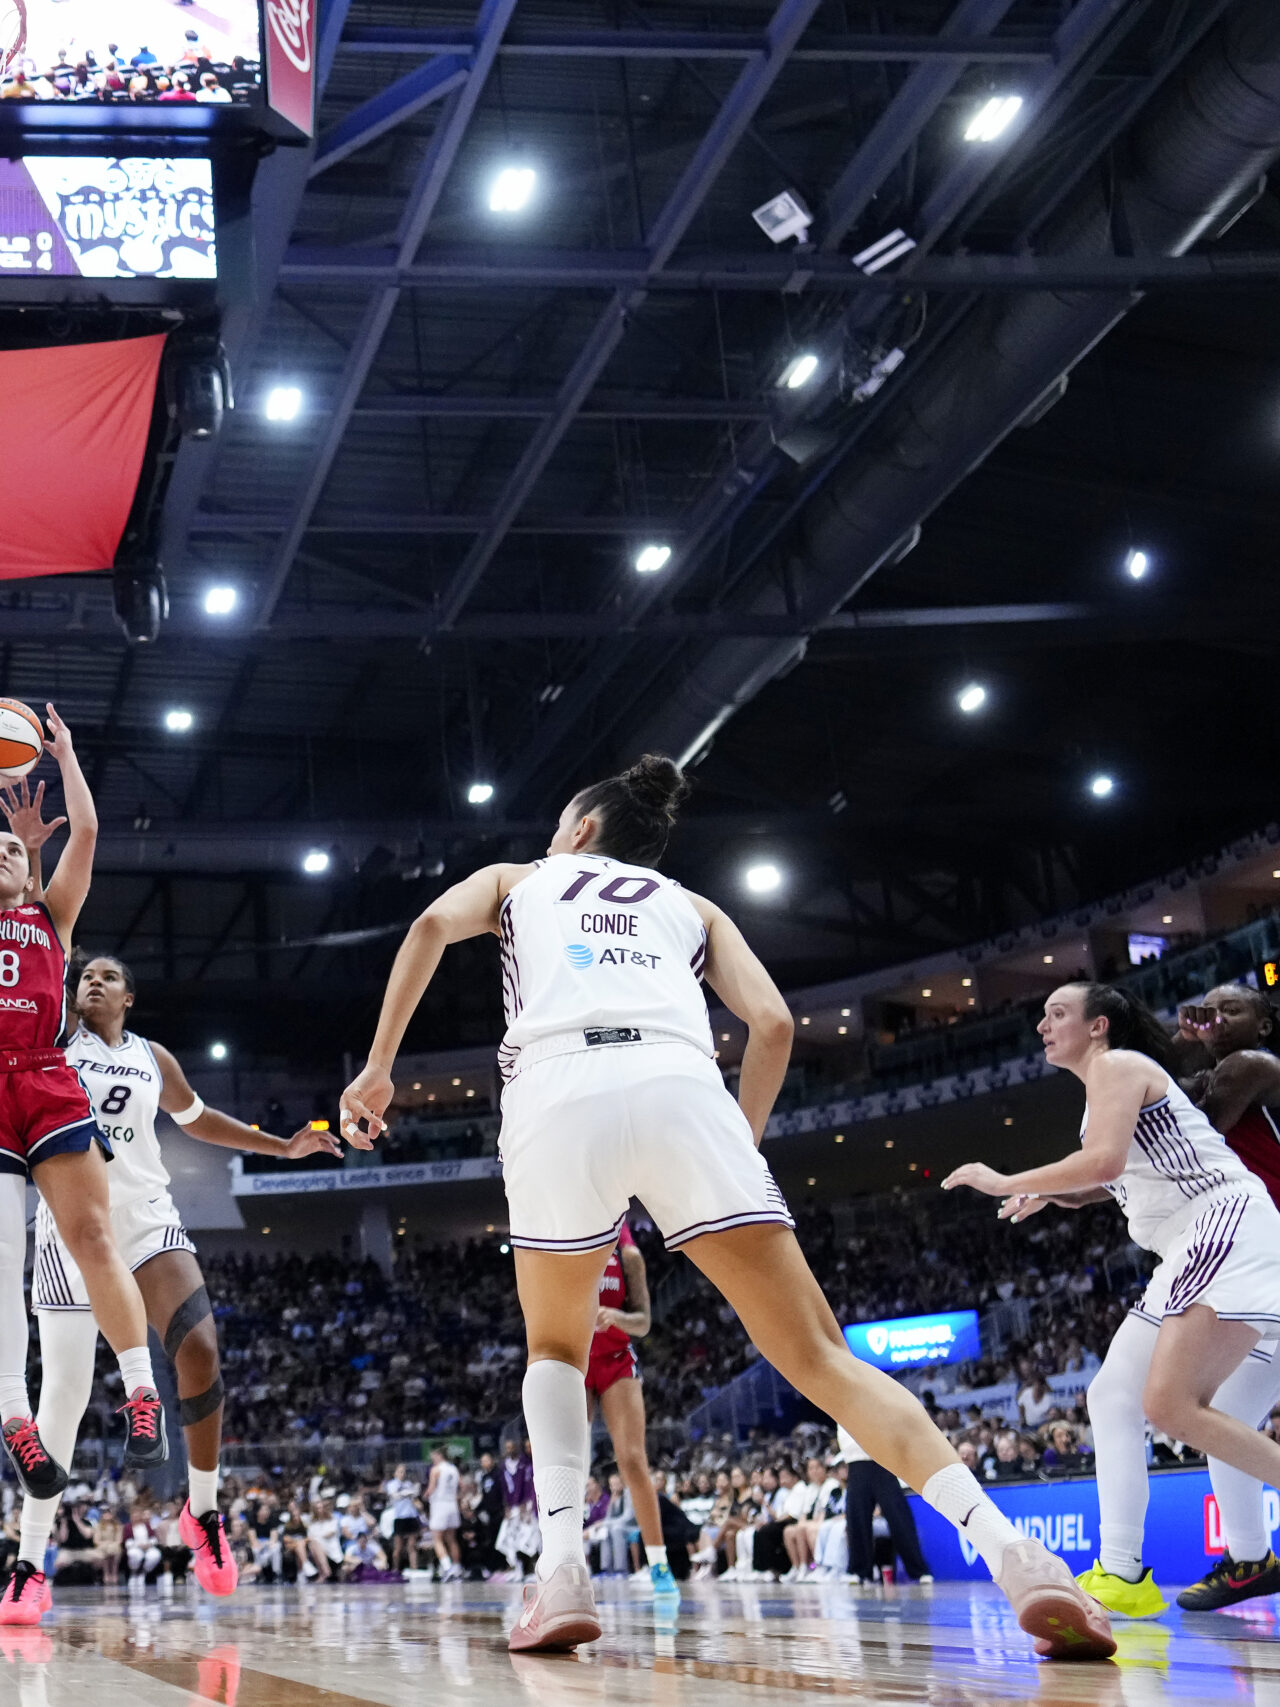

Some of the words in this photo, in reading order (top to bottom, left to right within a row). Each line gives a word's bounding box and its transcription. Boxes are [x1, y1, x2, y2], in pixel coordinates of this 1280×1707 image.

[36, 231, 53, 251] 0
[558, 870, 661, 905] 10
[581, 913, 639, 937] CONDE
[599, 947, 662, 969] AT&T
[77, 1059, 152, 1082] TEMPO
[100, 1085, 132, 1115] 8
